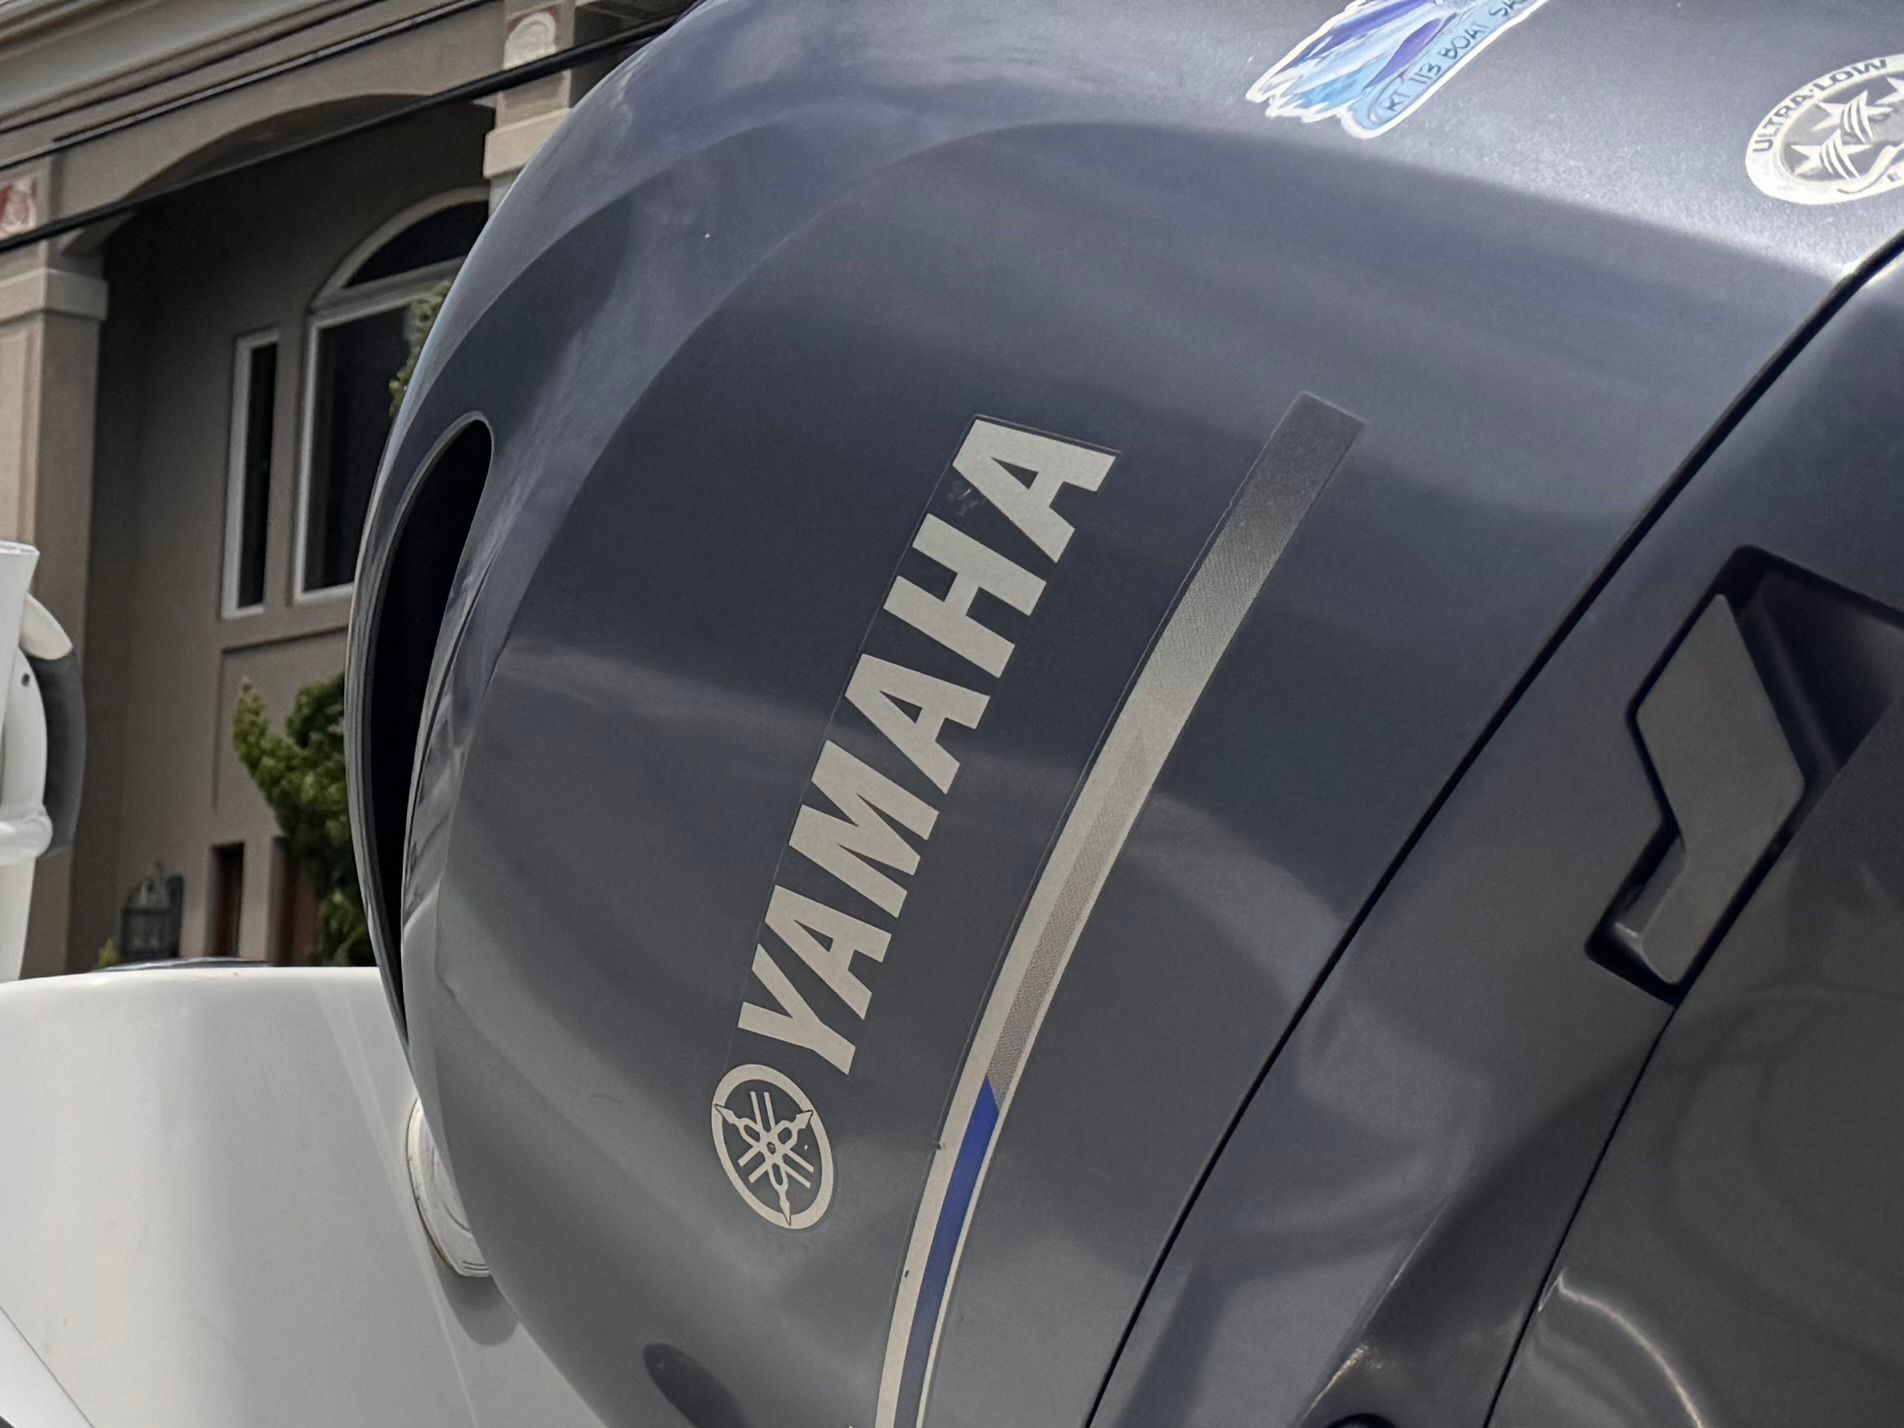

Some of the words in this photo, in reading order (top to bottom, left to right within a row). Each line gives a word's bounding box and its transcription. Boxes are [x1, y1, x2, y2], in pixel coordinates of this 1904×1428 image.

[1409, 62, 1443, 87] 113
[1438, 23, 1490, 61] BOAT
[738, 417, 1120, 1076] YAMAHA
